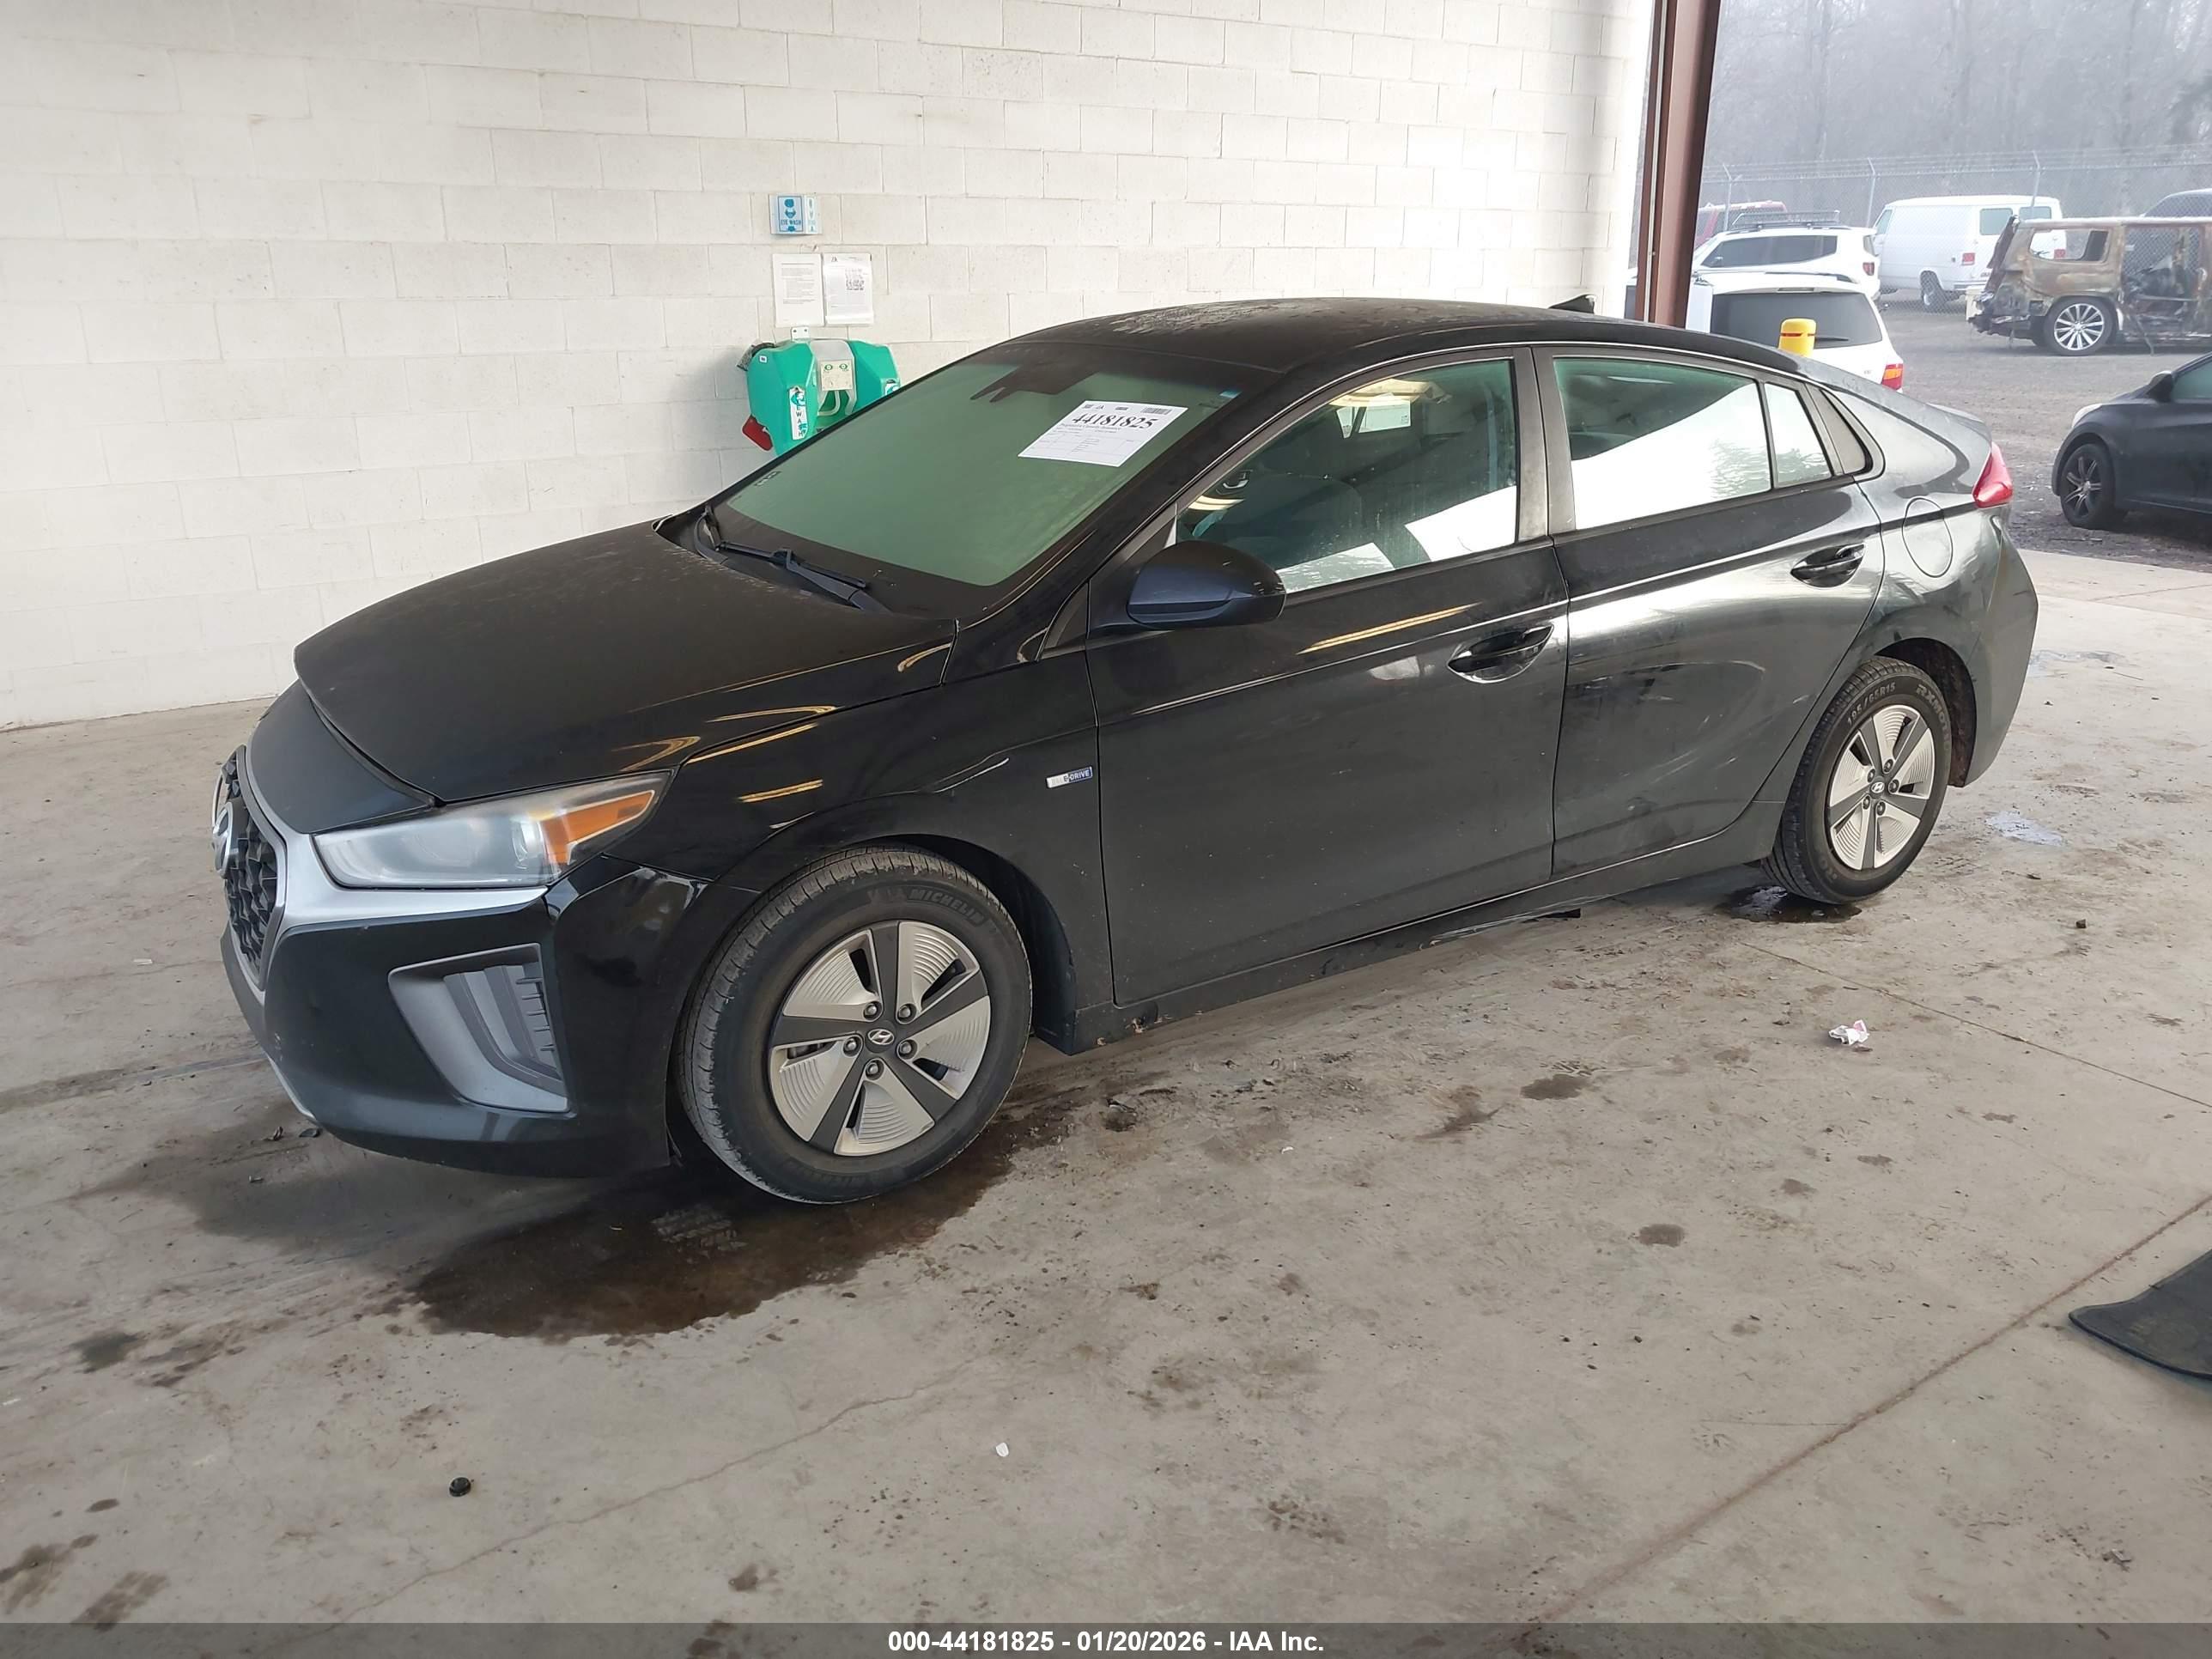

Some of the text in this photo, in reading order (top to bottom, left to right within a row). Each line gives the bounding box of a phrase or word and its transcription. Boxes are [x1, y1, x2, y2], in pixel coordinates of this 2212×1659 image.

[1072, 413, 1158, 428] 44181825
[1847, 682, 1896, 726] 195/65R15
[909, 889, 986, 925] MICHELIN
